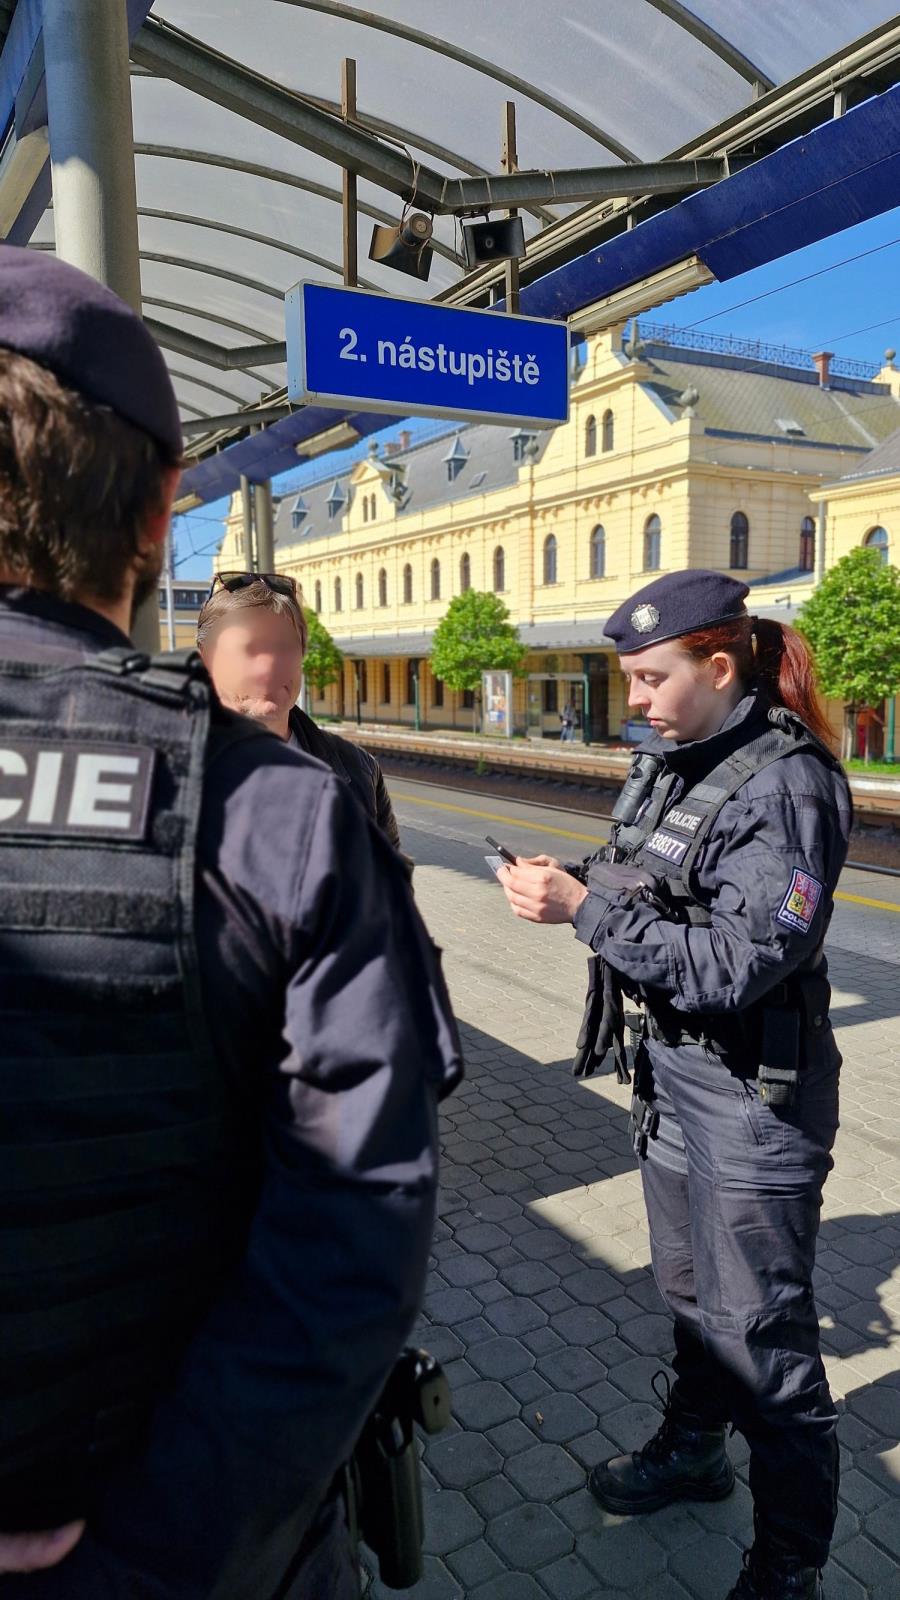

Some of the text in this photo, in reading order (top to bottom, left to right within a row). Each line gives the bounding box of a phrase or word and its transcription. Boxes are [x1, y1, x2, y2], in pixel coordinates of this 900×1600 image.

[338, 327, 540, 386] 2. nástupiště
[664, 809, 701, 830] POLICIE
[647, 832, 687, 859] 338377
